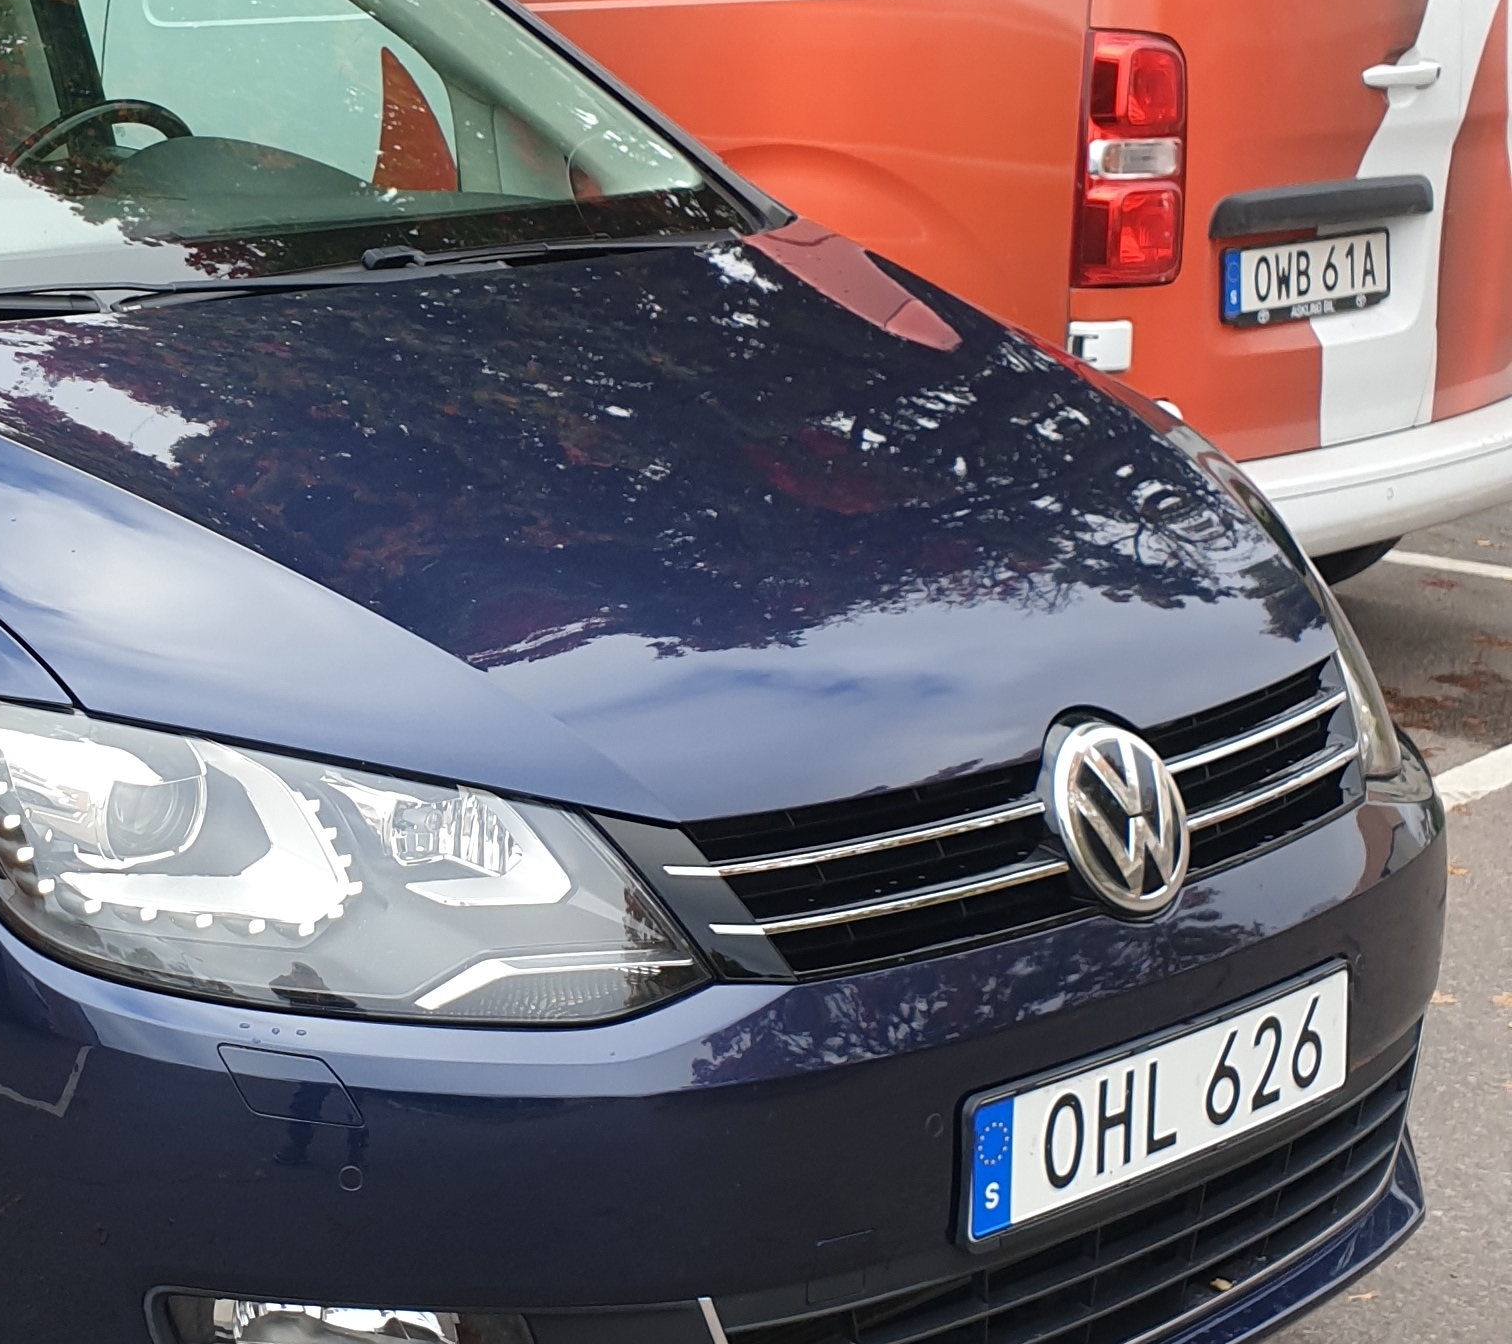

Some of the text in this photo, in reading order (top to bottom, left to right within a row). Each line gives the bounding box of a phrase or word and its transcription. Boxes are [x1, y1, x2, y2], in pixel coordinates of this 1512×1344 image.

[1254, 240, 1377, 303] OWB 61A
[1044, 992, 1323, 1190] OHL 626
[984, 1180, 1000, 1209] S
